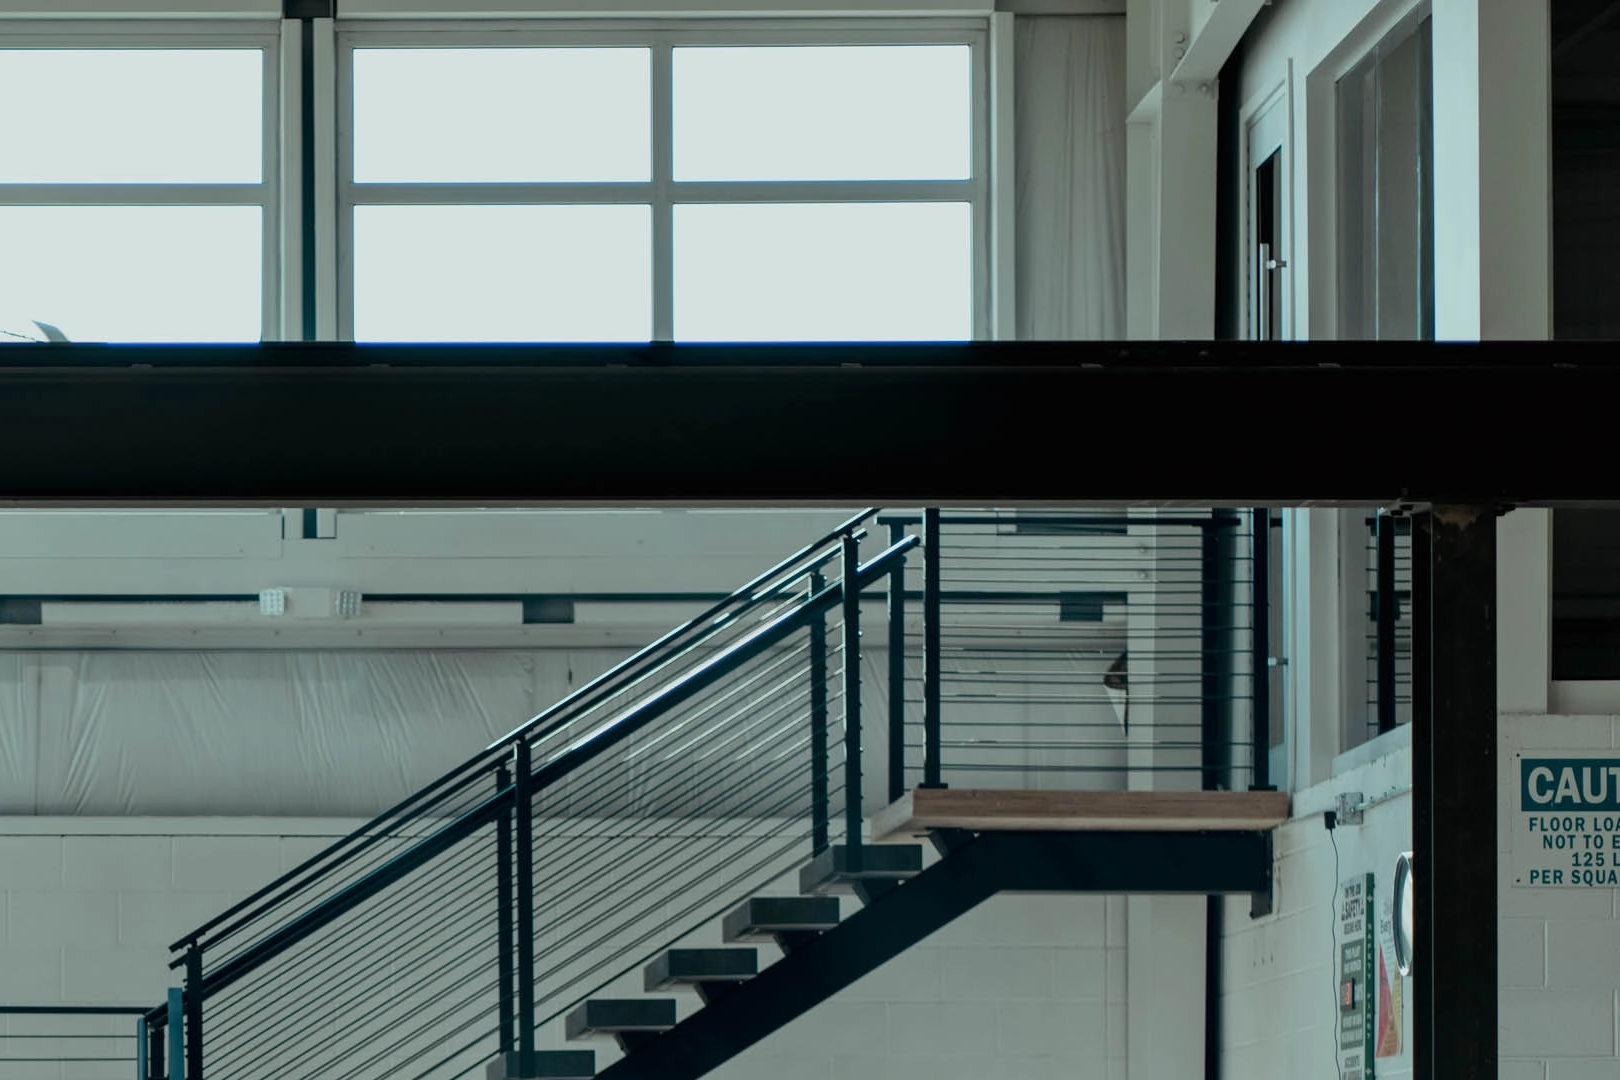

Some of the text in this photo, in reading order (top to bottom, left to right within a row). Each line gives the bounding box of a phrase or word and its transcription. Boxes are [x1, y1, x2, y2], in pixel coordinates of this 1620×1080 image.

[1529, 817, 1585, 832] FLOOR
[1542, 834, 1576, 849] NOT
[1583, 834, 1604, 849] TO
[1572, 852, 1605, 867] 125
[1530, 869, 1618, 887] PER SQUA
